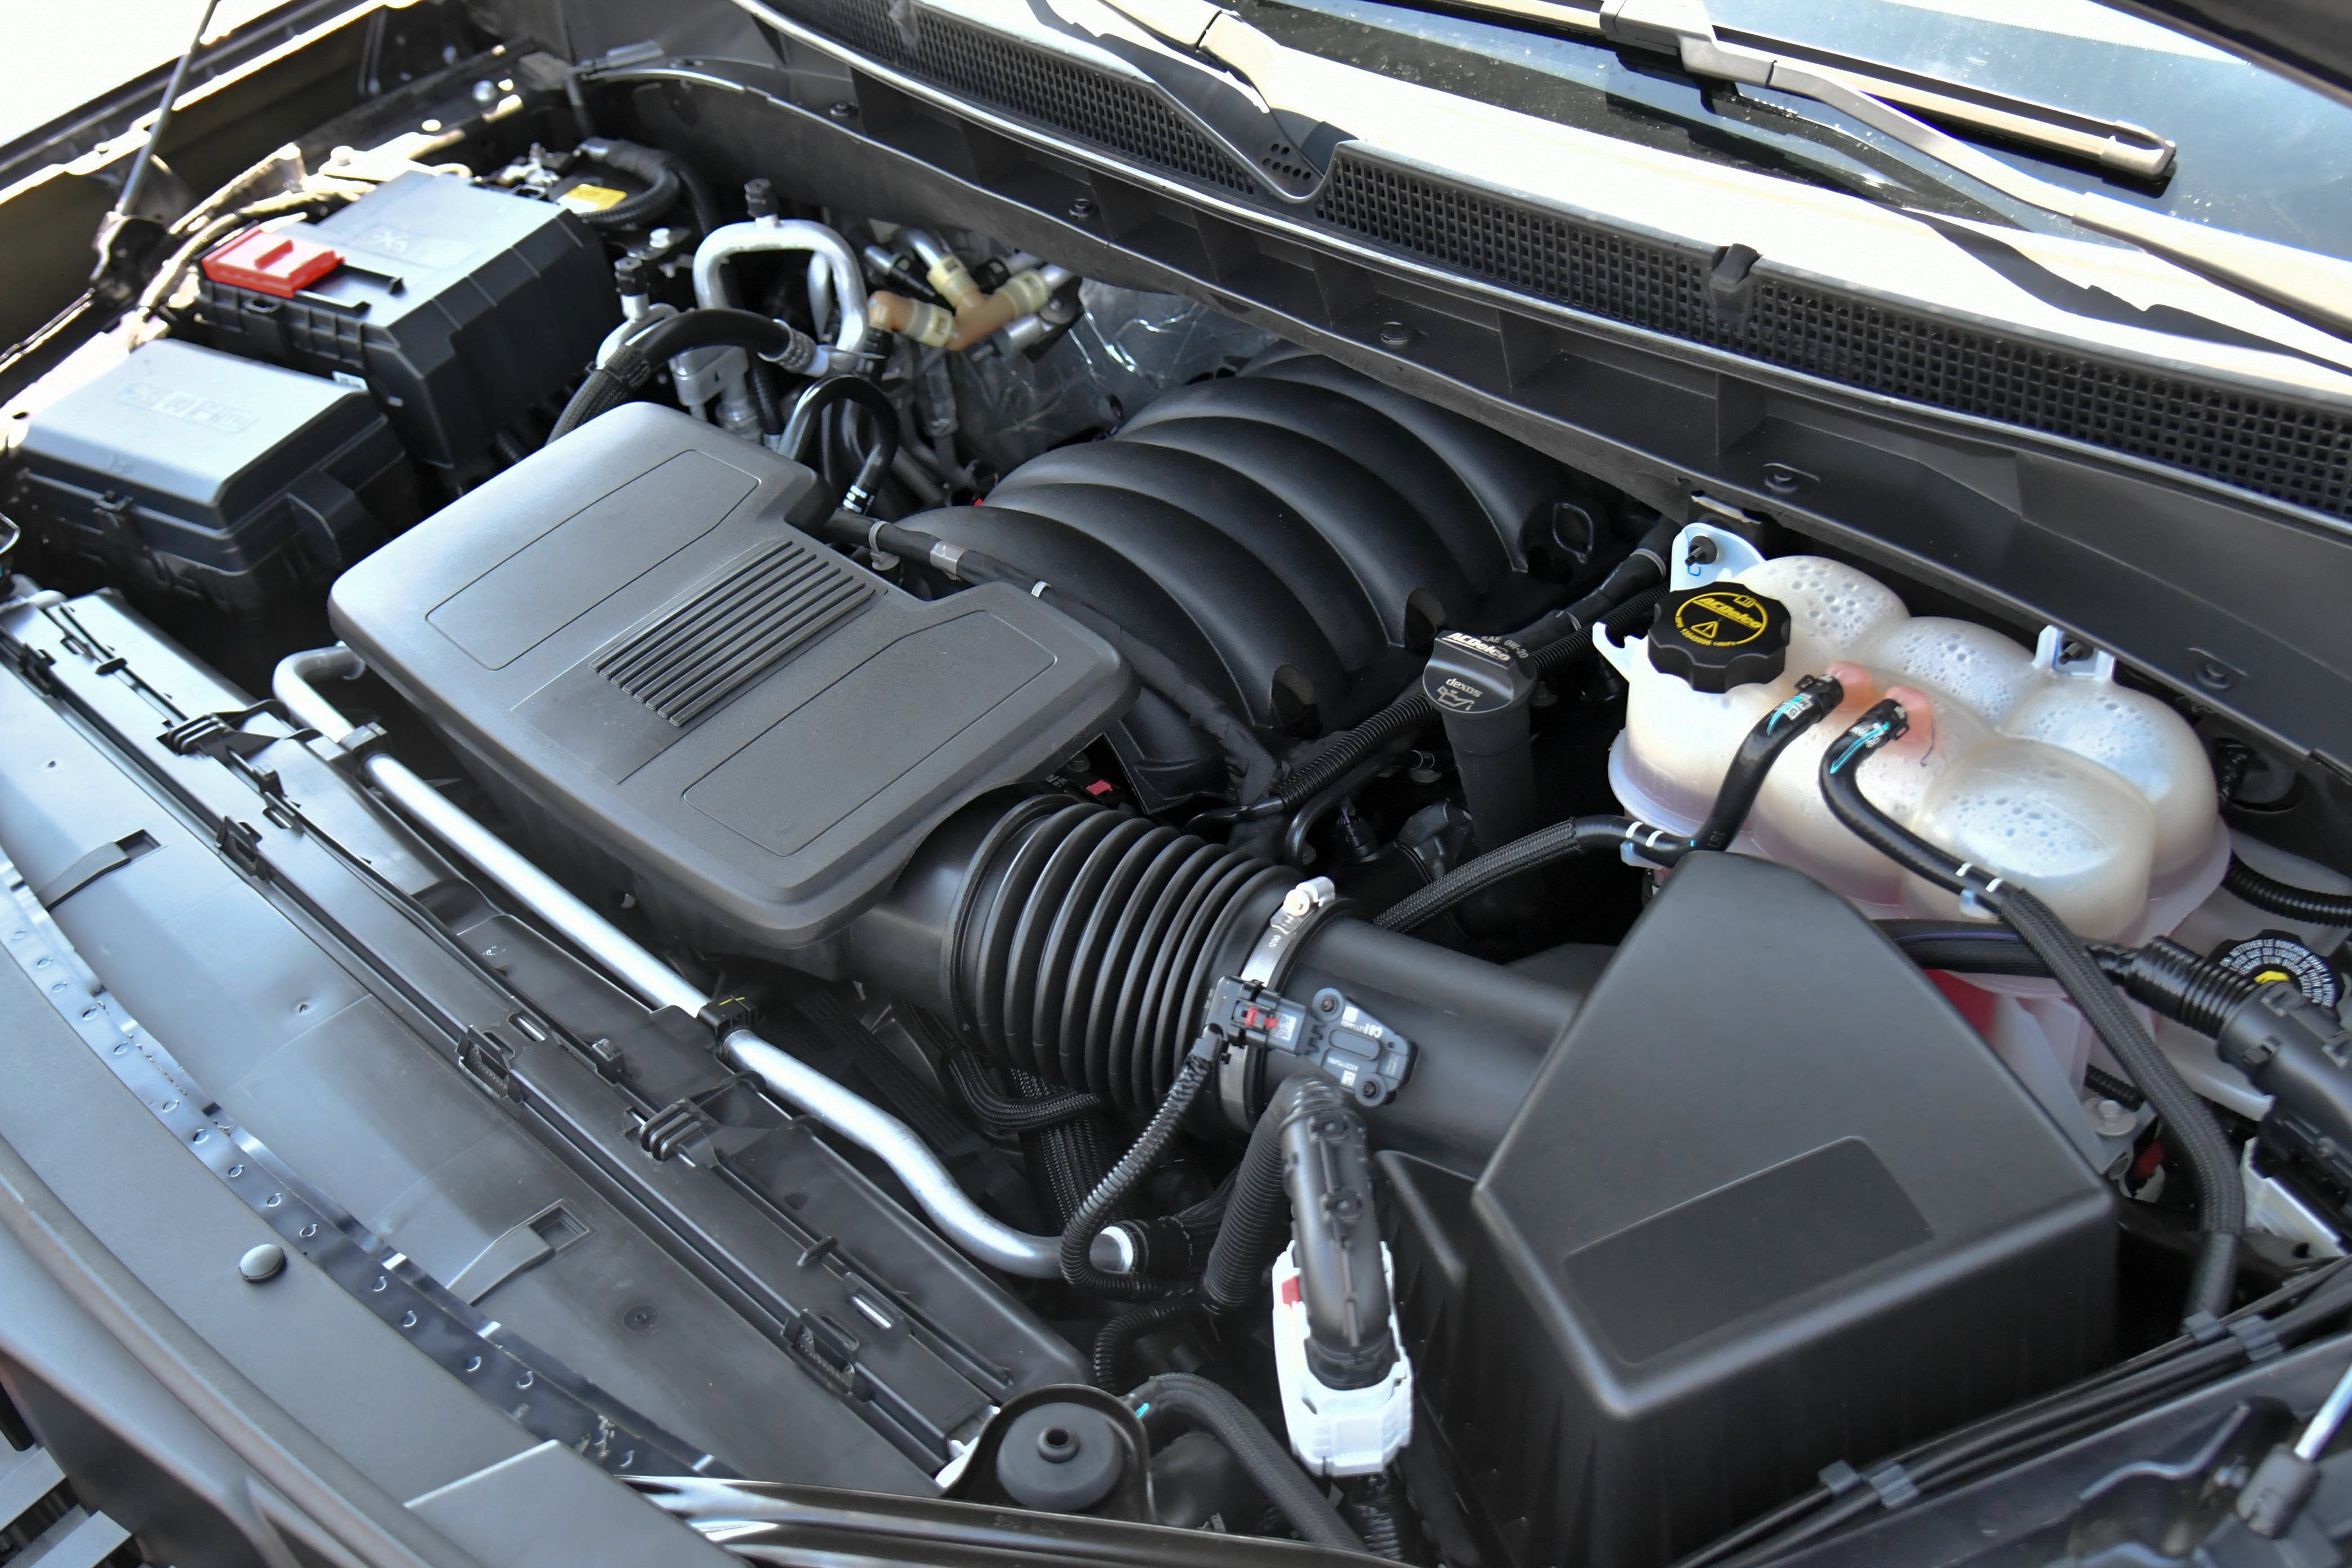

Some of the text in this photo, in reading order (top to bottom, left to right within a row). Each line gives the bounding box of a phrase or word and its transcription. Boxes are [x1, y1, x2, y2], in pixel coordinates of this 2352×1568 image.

[1693, 597, 1762, 629] ACDelco
[1442, 632, 1511, 661] ACDelco
[1504, 639, 1529, 658] 0W-20
[1445, 678, 1482, 697] dexos
[2229, 939, 2262, 957] NETTOYER
[2275, 940, 2310, 957] BOUCHON
[2306, 955, 2328, 973] AVANT
[2319, 973, 2332, 983] LA
[2246, 948, 2261, 959] QUE
[2274, 948, 2302, 964] LIQUIDE
[2299, 959, 2311, 970] DE
[2306, 969, 2321, 987] FREIN
[2282, 959, 2304, 975] BIDON
